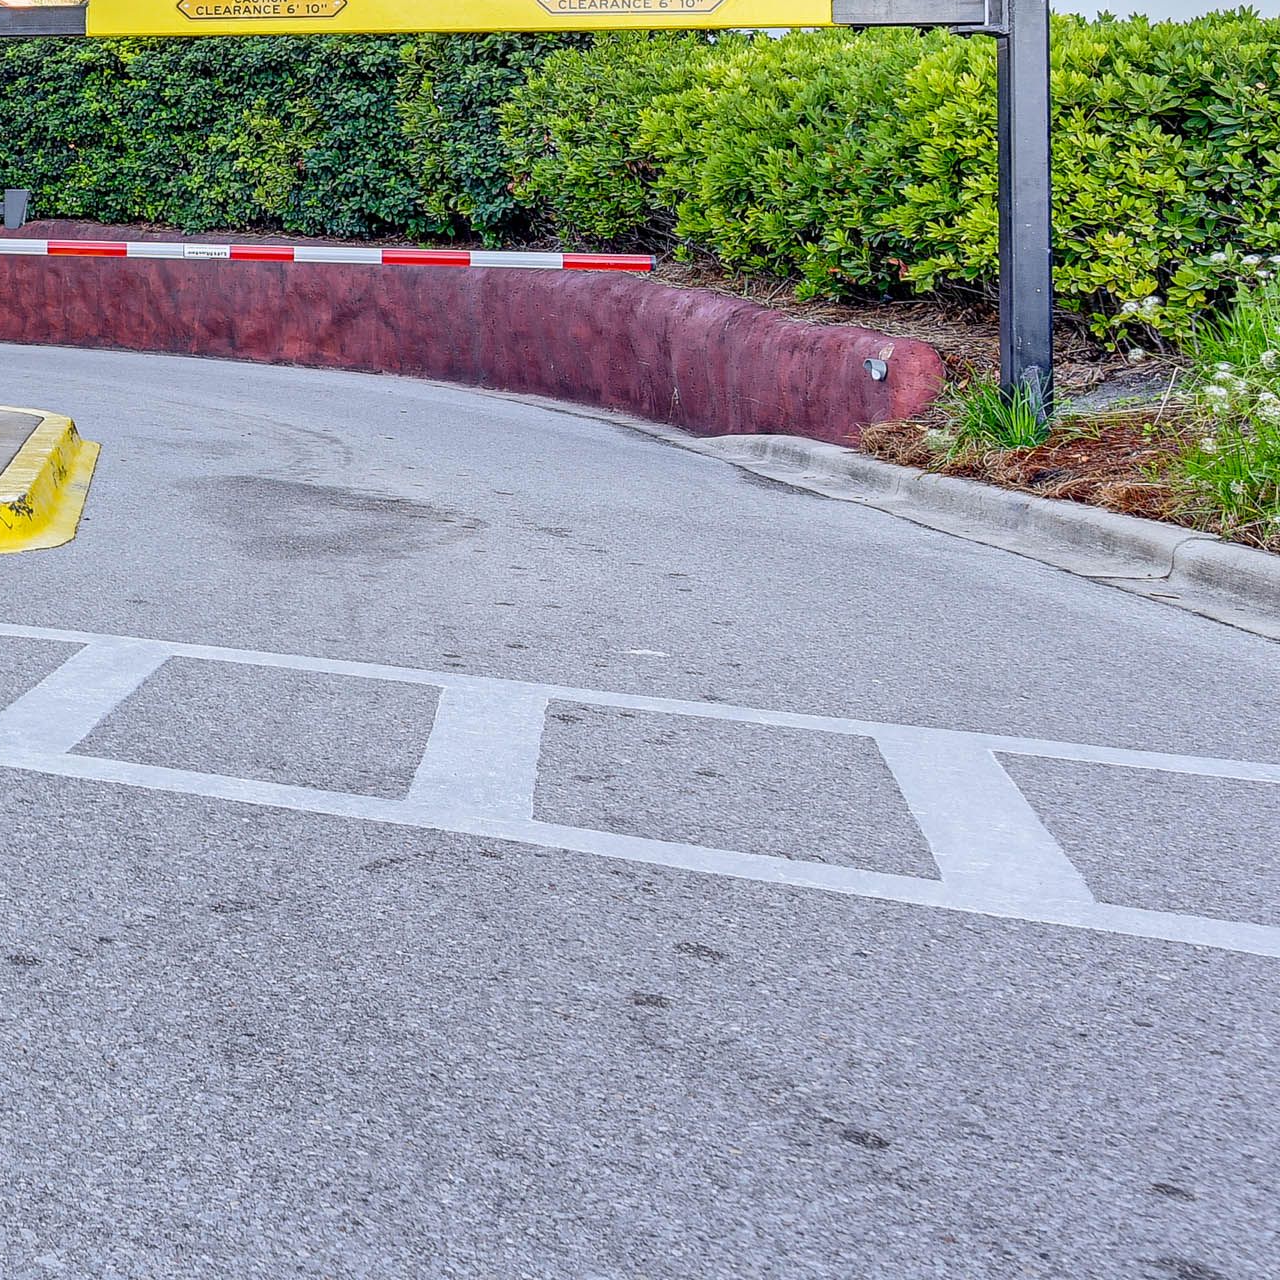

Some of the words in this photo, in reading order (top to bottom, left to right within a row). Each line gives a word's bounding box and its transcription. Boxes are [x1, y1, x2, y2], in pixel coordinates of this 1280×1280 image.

[195, 4, 281, 16] CLEARANCE
[286, 4, 300, 14] 6'
[306, 3, 328, 14] 10"
